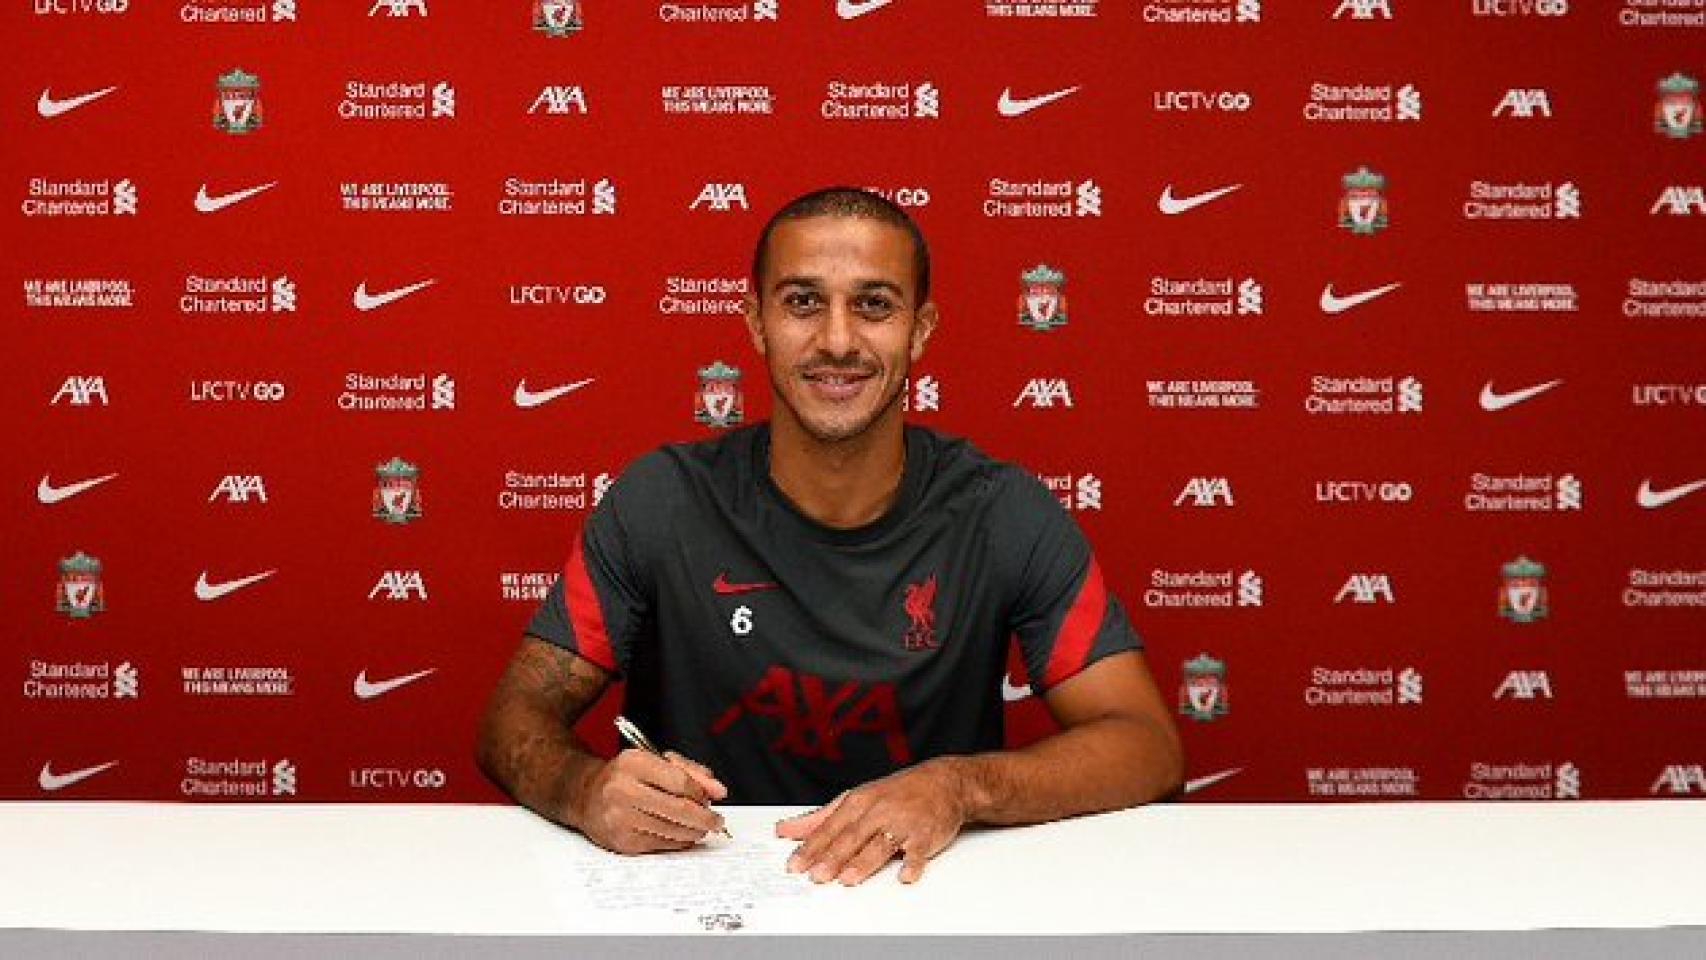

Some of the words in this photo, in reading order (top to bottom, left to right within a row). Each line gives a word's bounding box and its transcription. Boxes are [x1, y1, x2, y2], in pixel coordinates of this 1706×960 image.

[181, 4, 265, 22] Chartered
[660, 3, 747, 22] Chartered
[1143, 5, 1231, 22] Chartered
[346, 81, 425, 99] Standard
[827, 81, 908, 99] Standard
[1311, 83, 1390, 100] Standard
[527, 86, 587, 113] AXA
[1217, 92, 1250, 111] GO
[1493, 89, 1551, 116] AXA
[338, 100, 425, 119] Chartered
[822, 100, 909, 119] Chartered
[1303, 103, 1392, 122] Chartered
[30, 178, 108, 195] Standard
[505, 178, 584, 196] Standard
[990, 178, 1071, 195] Standard
[1471, 181, 1552, 198] Standard
[689, 184, 749, 210] AXA
[895, 188, 930, 206] GO
[1650, 187, 1706, 214] AXA
[21, 200, 108, 216] Chartered
[498, 200, 584, 214] Chartered
[984, 200, 1071, 216] Chartered
[1463, 202, 1552, 219] Chartered
[186, 276, 267, 292] Standard
[667, 277, 749, 293] Standard
[1151, 276, 1233, 294] Standard
[573, 286, 606, 303] GO
[181, 295, 267, 313] Chartered
[1144, 298, 1233, 316] Chartered
[51, 376, 108, 405] AXA
[254, 381, 284, 400] GO
[346, 373, 425, 390] Standard
[1311, 376, 1392, 392] Standard
[338, 392, 425, 409] Chartered
[1014, 379, 1073, 408] AXA
[1305, 395, 1392, 414] Chartered
[505, 471, 584, 487] Standard
[1471, 473, 1552, 491] Standard
[208, 476, 268, 503] AXA
[1174, 478, 1233, 506] AXA
[1379, 482, 1412, 501] GO
[499, 492, 584, 509] Chartered
[1465, 494, 1552, 511] Chartered
[368, 571, 427, 600] AXA
[1152, 568, 1233, 587] Standard
[1144, 589, 1233, 606] Chartered
[1335, 574, 1395, 603] AXA
[730, 605, 752, 634] 6
[30, 660, 108, 678] Standard
[1311, 668, 1392, 684] Standard
[24, 679, 108, 698] Chartered
[1493, 671, 1552, 698] AXA
[1305, 687, 1392, 706] Chartered
[712, 665, 912, 765] AXA
[187, 757, 266, 775] Standard
[1471, 762, 1552, 779] Standard
[181, 778, 266, 795] Chartered
[414, 770, 446, 787] GO
[1652, 765, 1706, 791] AXA
[1465, 780, 1552, 798] Chartered
